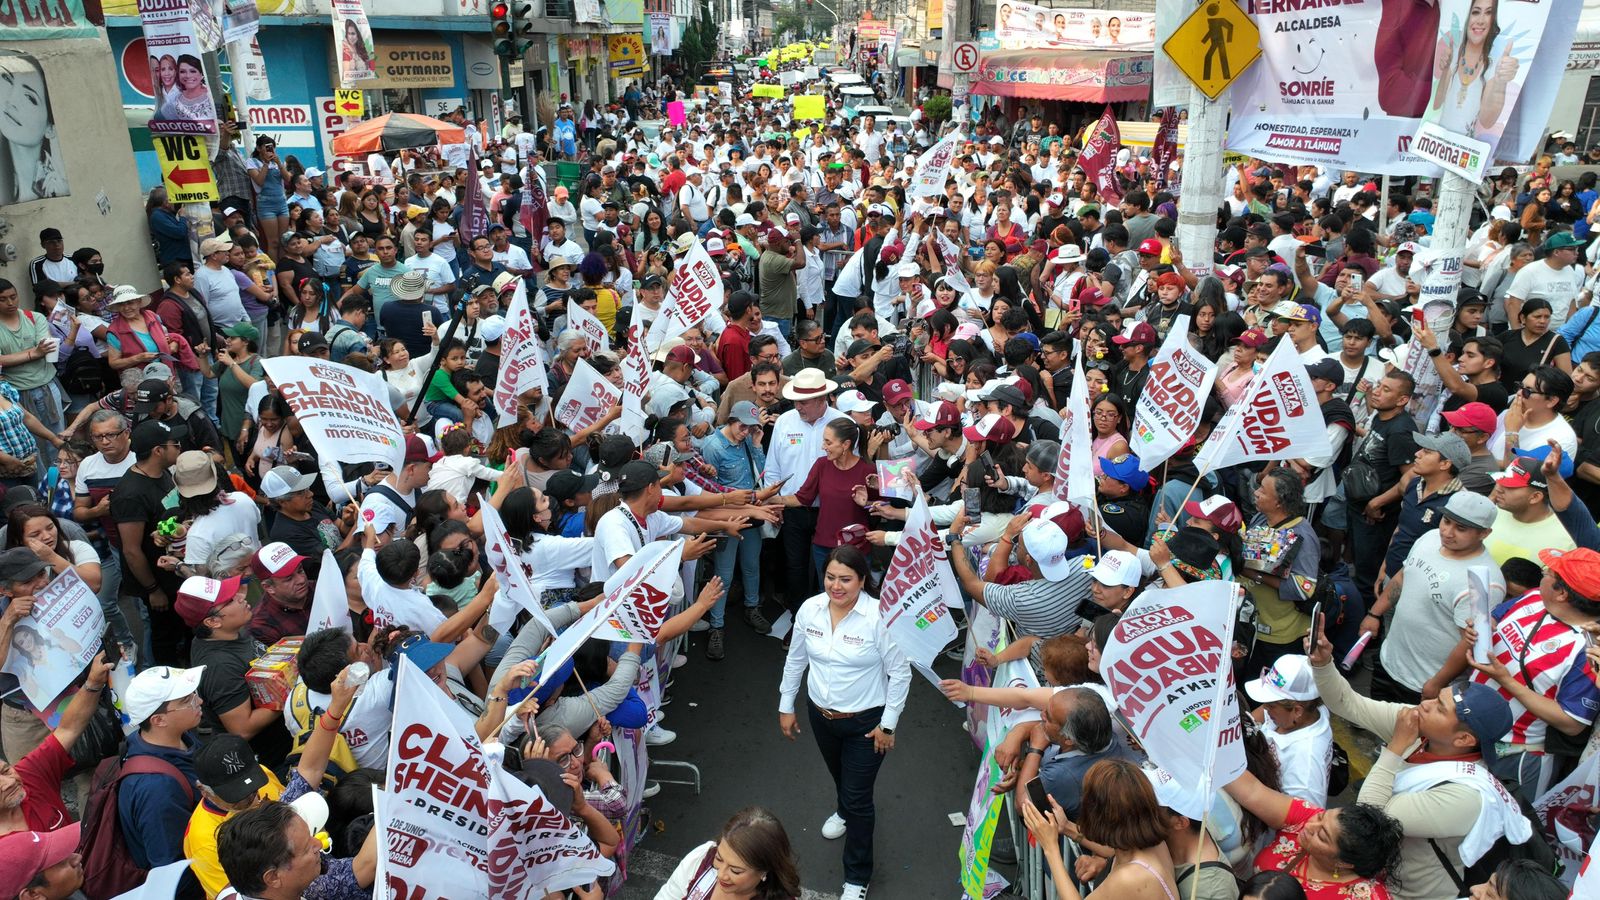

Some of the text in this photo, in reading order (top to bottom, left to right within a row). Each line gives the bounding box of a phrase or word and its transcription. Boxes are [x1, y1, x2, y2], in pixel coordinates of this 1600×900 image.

[1275, 15, 1341, 33] ALCALDESA
[389, 51, 446, 60] OPTICAS
[1566, 60, 1595, 69] OTA
[387, 66, 451, 75] GUTMARD
[339, 90, 360, 100] WC
[1279, 76, 1335, 97] SONRÍE
[155, 122, 206, 131] morena
[1254, 123, 1359, 138] HONESTIDAD, ESPERANZA Y
[160, 135, 200, 161] WC
[1268, 137, 1295, 148] AMOR
[1304, 138, 1340, 152] TLÁHUAC
[1417, 136, 1459, 164] morena
[175, 192, 209, 201] LIMPIOS
[375, 279, 391, 287] PUM
[699, 265, 713, 285] VOTA
[679, 263, 711, 316] CUDIA
[1405, 340, 1422, 373] LARA
[320, 367, 349, 382] VOTA
[1178, 354, 1202, 382] VOTA
[278, 381, 391, 417] CLAUDIA
[1151, 361, 1200, 421] AUDIA
[1283, 376, 1301, 411] VOTA
[1298, 387, 1308, 408] JUNIO
[287, 395, 396, 427] SHEINBAUM
[320, 411, 386, 430] PRESIDENTA
[1253, 390, 1292, 454] UDIA
[325, 429, 380, 443] morena
[32, 574, 77, 619] CLARA
[74, 606, 93, 627] VOTA
[83, 636, 102, 661] moren
[415, 797, 488, 837] PRESID
[402, 823, 426, 836] JUNIO
[389, 851, 413, 866] ORENA
[525, 843, 562, 857] SIGAMOS
